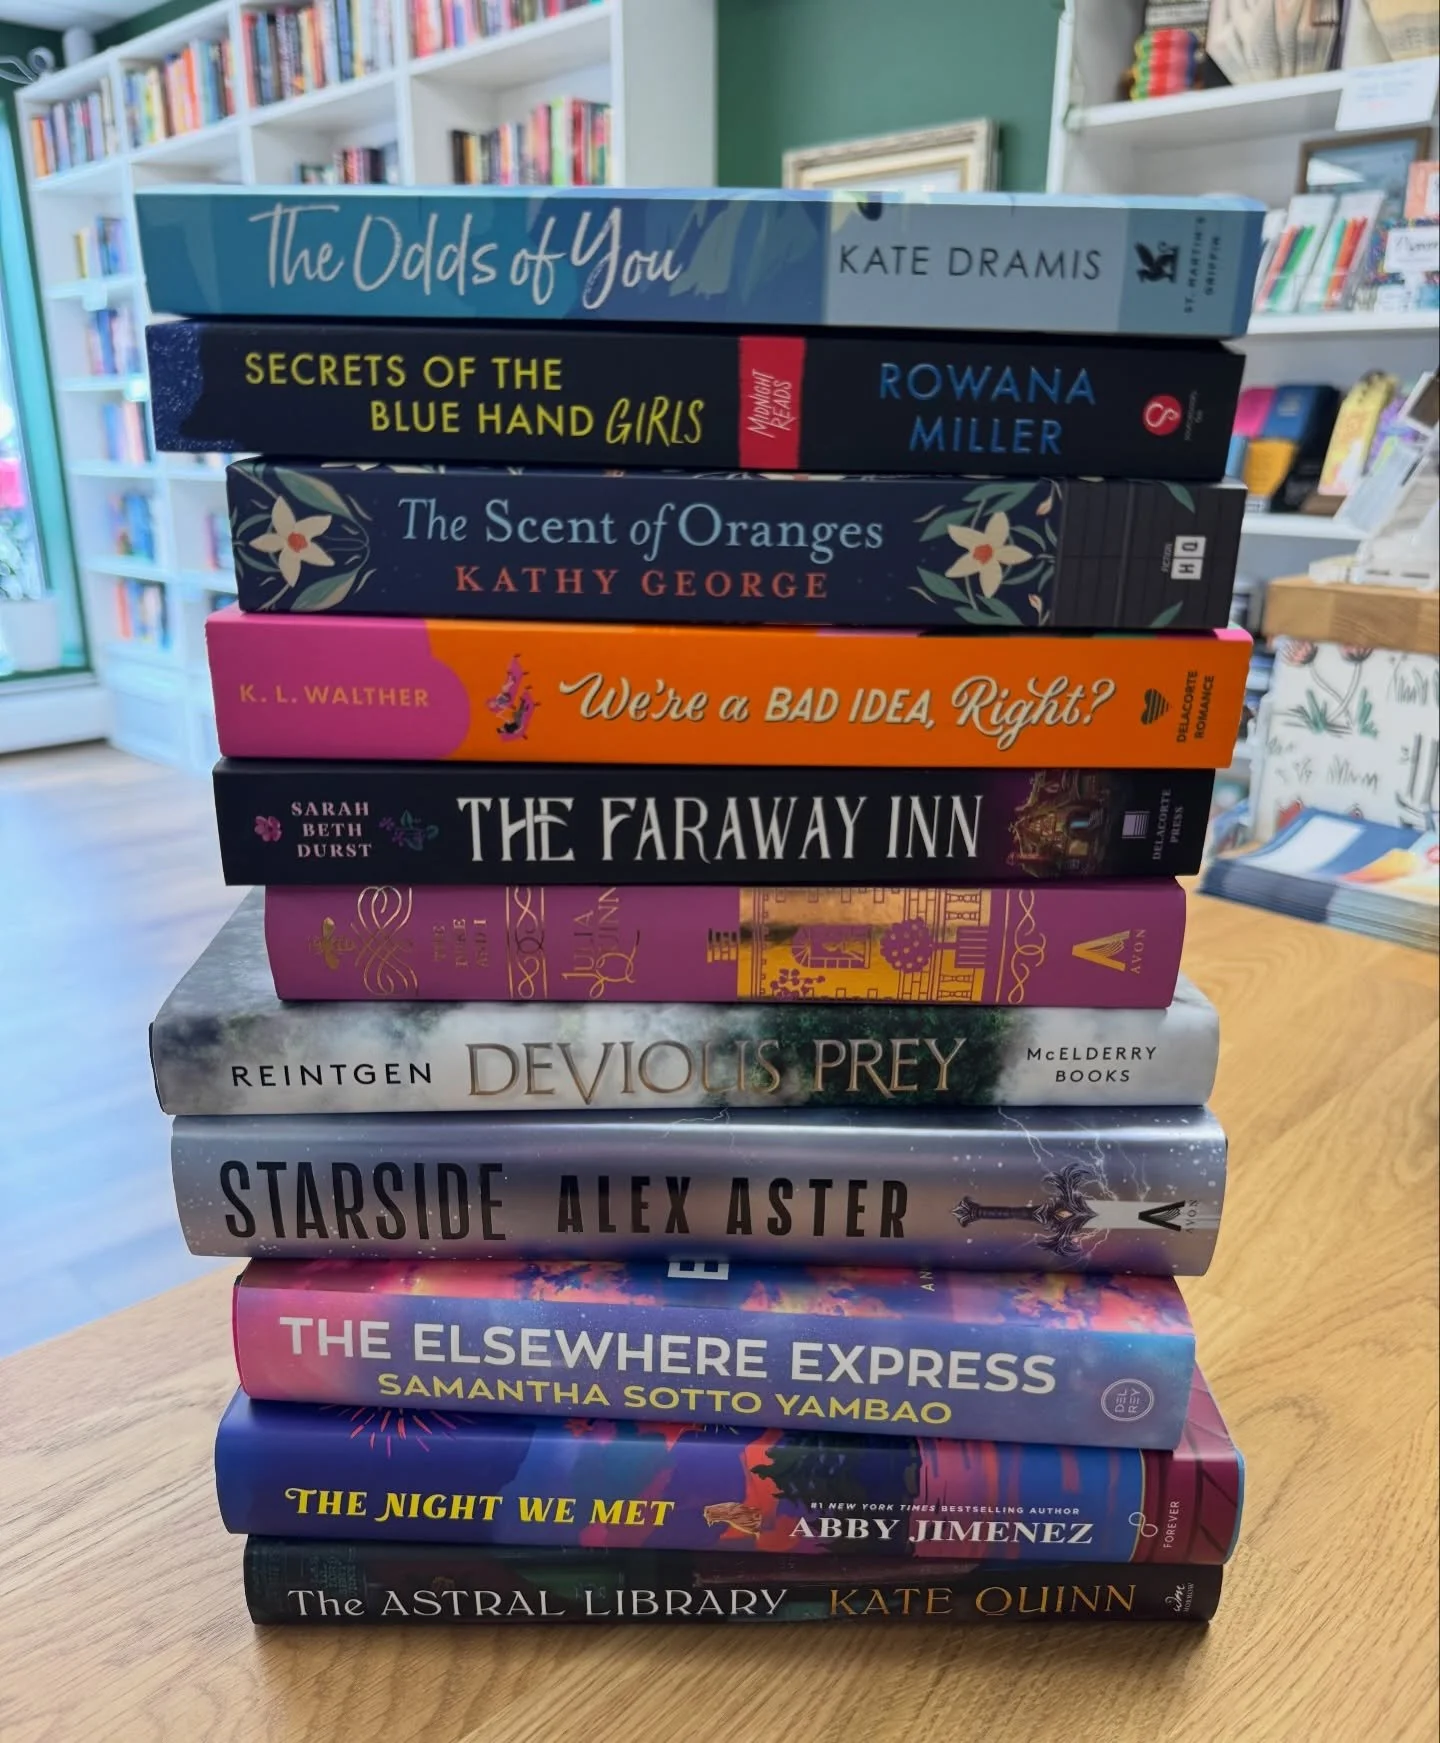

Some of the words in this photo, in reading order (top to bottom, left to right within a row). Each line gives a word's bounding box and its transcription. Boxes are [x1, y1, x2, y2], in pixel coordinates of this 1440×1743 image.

[249, 202, 344, 288] The
[353, 213, 498, 295] Odds
[510, 216, 566, 306] of
[571, 207, 682, 309] You
[839, 245, 929, 275] KATE
[949, 248, 1102, 281] DRAMIS
[245, 352, 406, 387] SECRETS
[423, 356, 476, 388] OF
[491, 357, 562, 390] THE
[880, 362, 1097, 406] ROWANA
[370, 402, 459, 433] BLUE
[479, 403, 594, 437] HAND
[605, 395, 704, 447] GIRLS
[770, 379, 797, 431] READS
[909, 415, 1063, 455] MILLER
[399, 498, 468, 541] The
[485, 499, 617, 545] Scent
[630, 503, 674, 562] of
[679, 503, 883, 564] Oranges
[455, 566, 619, 595] KATHY
[641, 570, 828, 598] GEORGE
[240, 684, 266, 703] K.
[276, 684, 297, 704] L.
[306, 685, 429, 708] WALTHER
[559, 672, 707, 724] We're
[719, 696, 750, 723] a
[765, 687, 839, 723] BAD
[850, 688, 935, 730] IDEA,
[951, 675, 1116, 752] Right?
[1177, 670, 1198, 743] DELACORTE
[1194, 675, 1215, 739] ROMANCE
[291, 801, 370, 816] SARAH
[1152, 789, 1172, 860] DELACORTE
[1169, 806, 1184, 843] PRESS
[302, 822, 363, 837] BETH
[456, 796, 576, 862] THE
[601, 795, 868, 865] FARAWAY
[886, 794, 983, 859] INN
[297, 843, 372, 858] DURST
[1130, 929, 1146, 975] AVON
[232, 1062, 432, 1087] REINTGEN
[465, 1038, 781, 1106] DEVIOUS
[812, 1037, 967, 1100] PREY
[1026, 1046, 1157, 1061] McELDERRY
[1055, 1069, 1131, 1083] BOOKS
[219, 1159, 506, 1242] STARSIDE
[557, 1174, 691, 1235] ALEX
[726, 1177, 908, 1239] ASTER
[1185, 1200, 1199, 1233] AVON
[280, 1316, 391, 1360] THE
[413, 1322, 768, 1379] ELSEWHERE
[791, 1341, 1057, 1395] EXPRESS
[377, 1373, 610, 1406] SAMANTHA
[623, 1385, 762, 1415] SOTTO
[775, 1393, 953, 1425] YAMBAO
[1114, 1388, 1128, 1413] DEL
[1128, 1387, 1141, 1413] REY
[285, 1487, 367, 1517] THE
[375, 1492, 502, 1523] NIGHT
[518, 1497, 576, 1524] WE
[589, 1499, 675, 1527] MET
[810, 1502, 824, 1510] #1
[828, 1502, 857, 1511] NEW
[861, 1503, 895, 1512] YORK
[900, 1504, 936, 1513] TIMES
[941, 1505, 1024, 1515] BESTSELLING
[1029, 1507, 1080, 1516] AUTHOR
[1163, 1501, 1180, 1548] FOREVER
[788, 1515, 901, 1541] ABBY
[909, 1519, 1094, 1545] JIMENEZ
[287, 1590, 365, 1617] The
[380, 1589, 566, 1617] ASTRAL
[584, 1588, 788, 1617] LIBRARY
[829, 1588, 954, 1616] KATE
[975, 1584, 1137, 1618] QUINN
